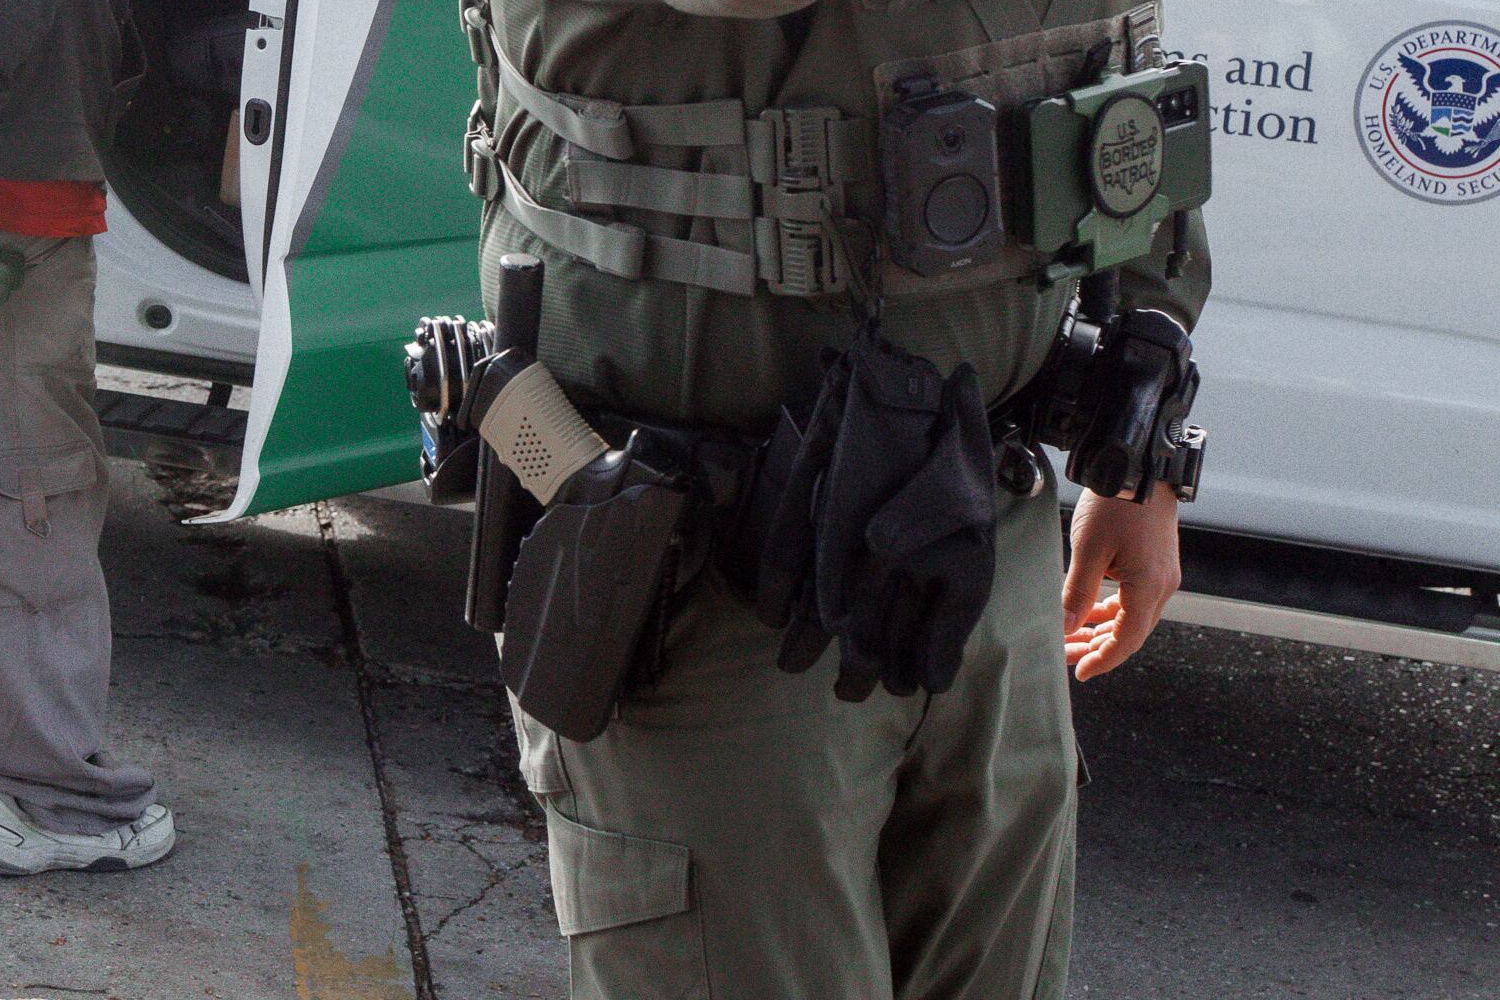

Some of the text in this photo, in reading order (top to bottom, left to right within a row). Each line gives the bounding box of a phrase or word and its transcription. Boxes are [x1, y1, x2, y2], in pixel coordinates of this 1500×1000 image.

[1225, 50, 1314, 92] and
[1369, 29, 1500, 91] U.S. DEPARTM
[1364, 114, 1447, 196] HOMELAND
